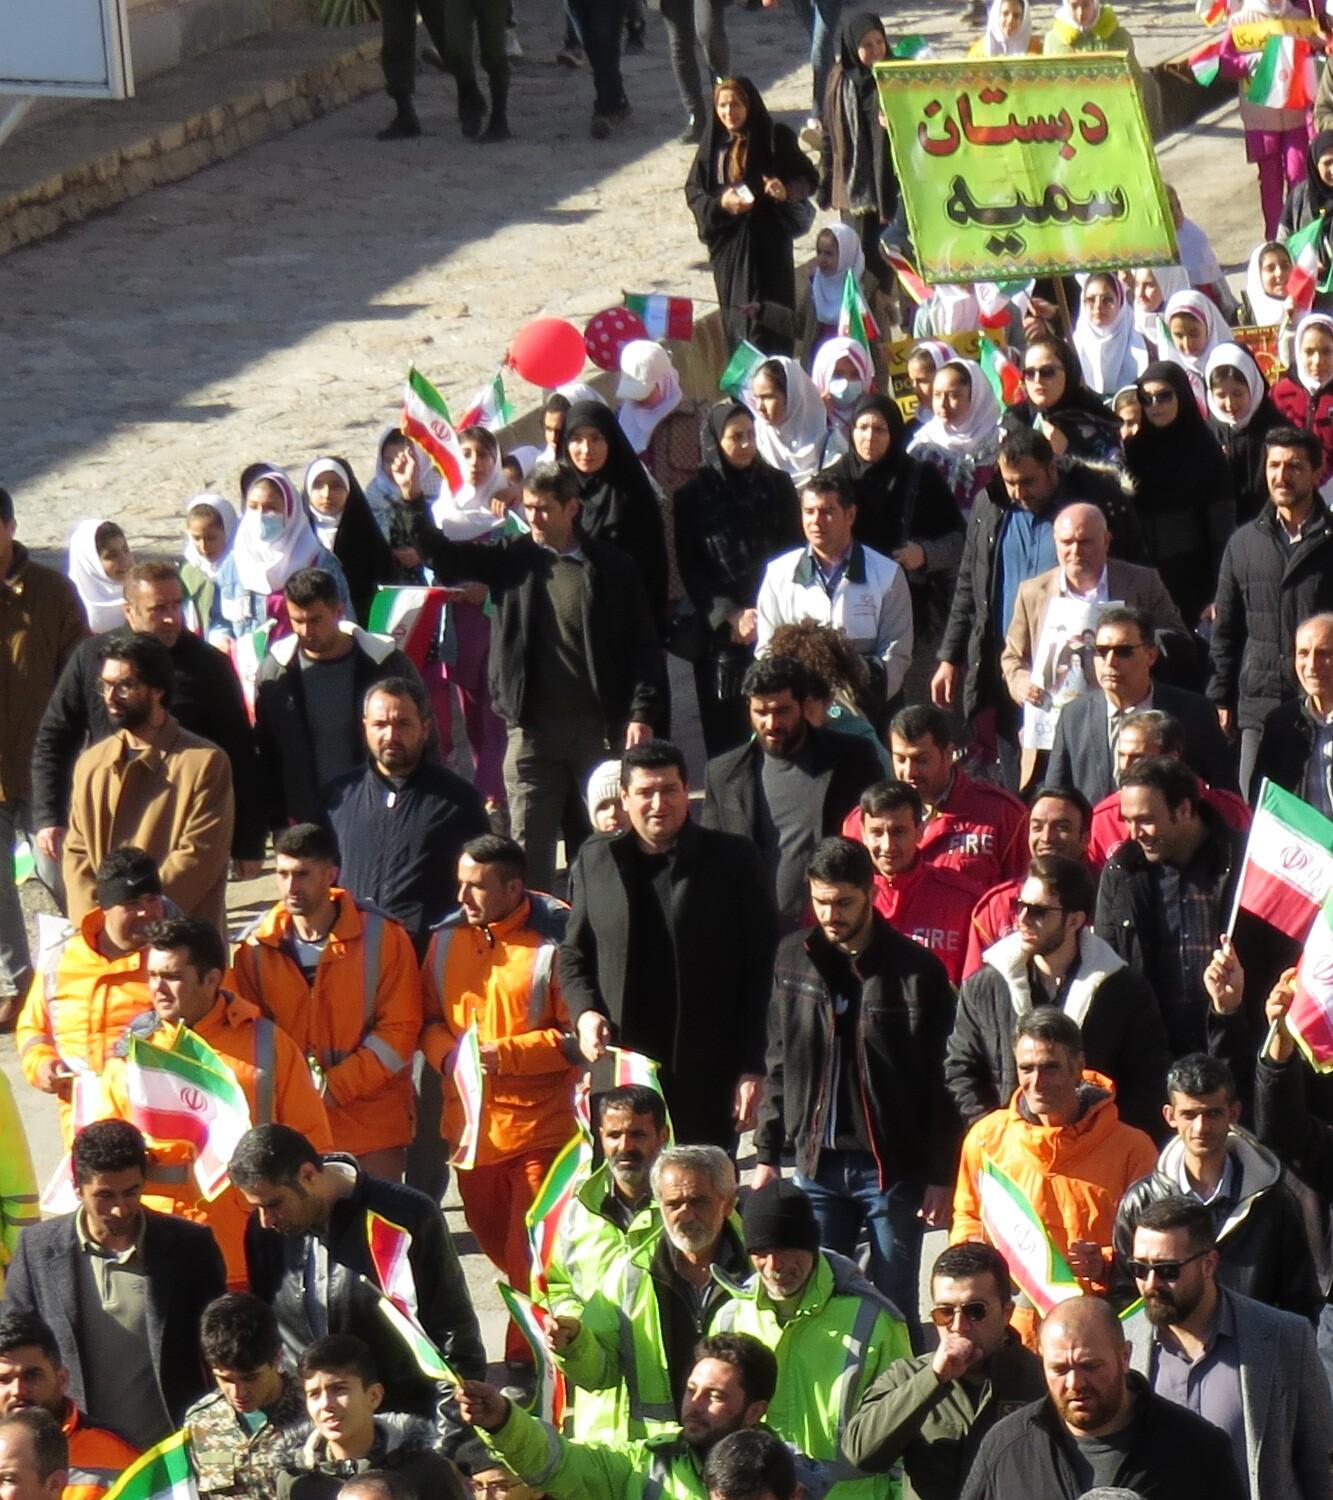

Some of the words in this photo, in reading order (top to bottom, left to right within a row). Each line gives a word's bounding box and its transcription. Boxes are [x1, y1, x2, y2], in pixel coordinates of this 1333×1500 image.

[917, 87, 1108, 160] دبستان
[946, 175, 1128, 256] سمیه
[949, 833, 994, 855] FIRE
[911, 927, 960, 951] FIRE
